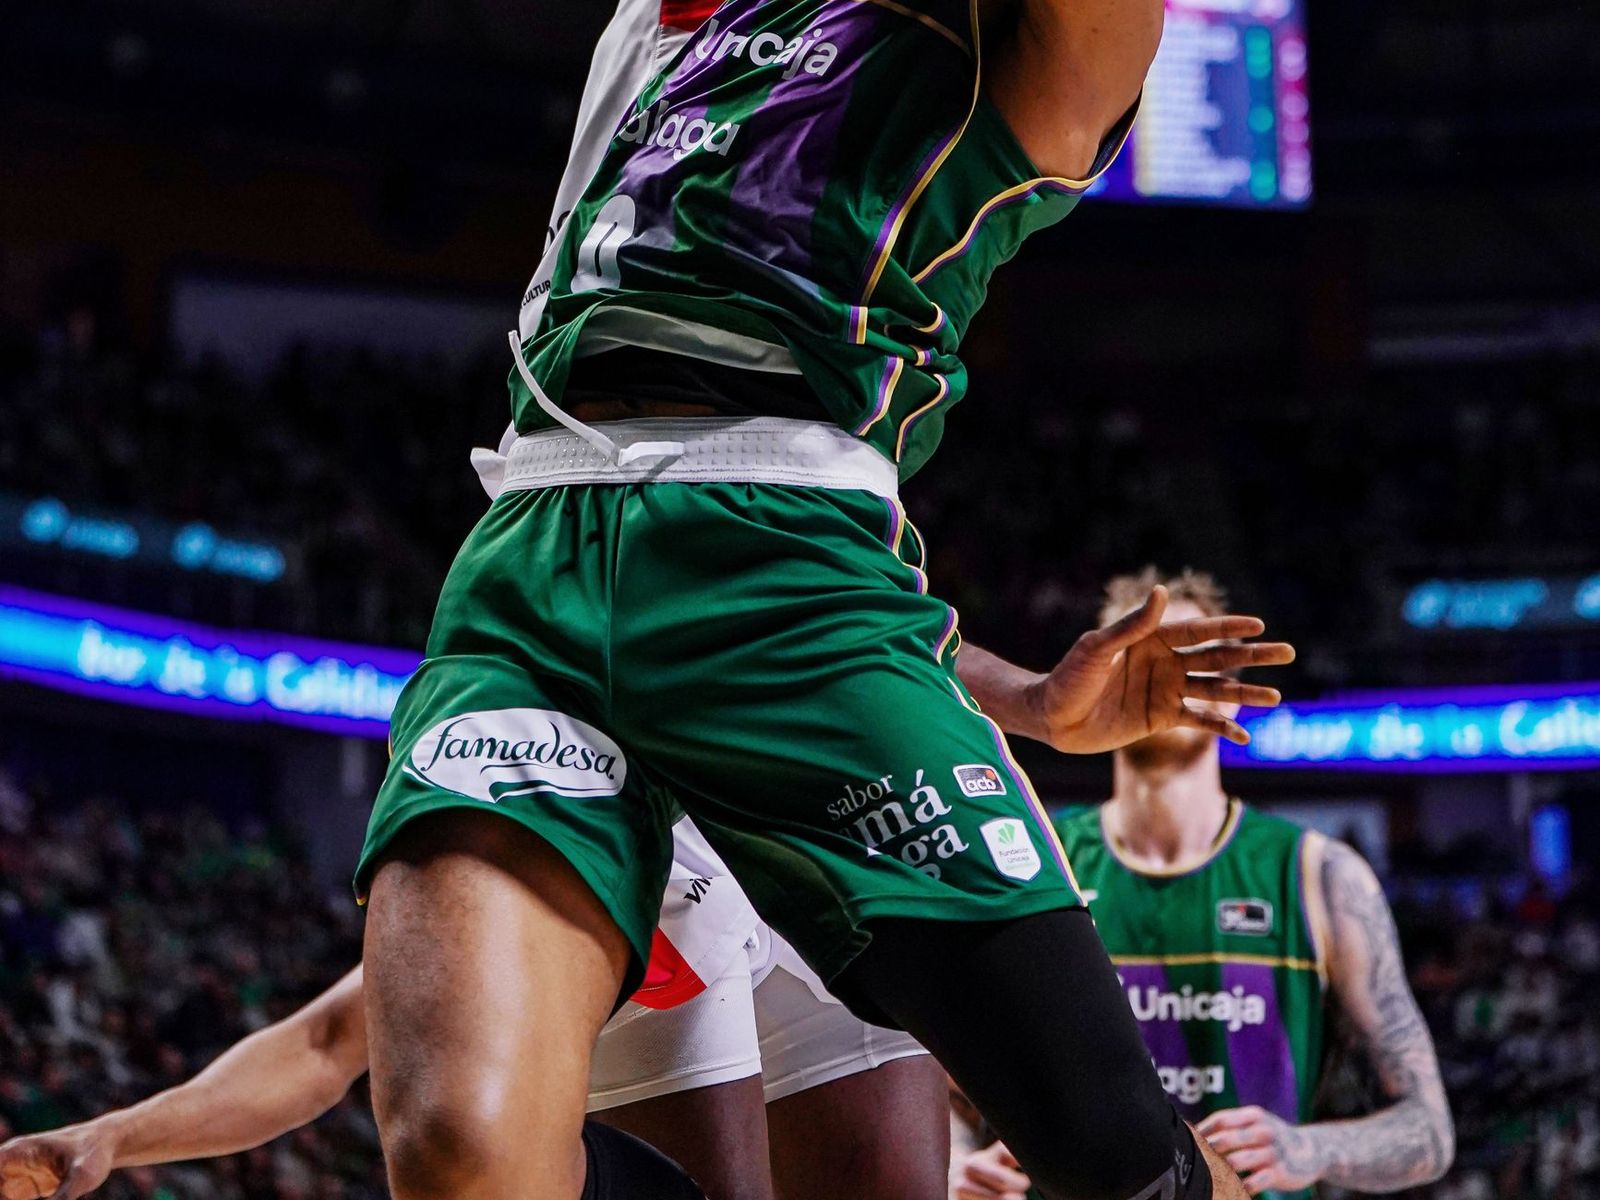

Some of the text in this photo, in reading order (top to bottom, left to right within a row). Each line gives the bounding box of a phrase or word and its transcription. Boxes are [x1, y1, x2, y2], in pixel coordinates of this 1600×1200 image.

[421, 717, 616, 780] famadesa
[827, 774, 894, 820] sabor
[966, 776, 997, 792] acb
[1127, 984, 1266, 1032] Unicaja
